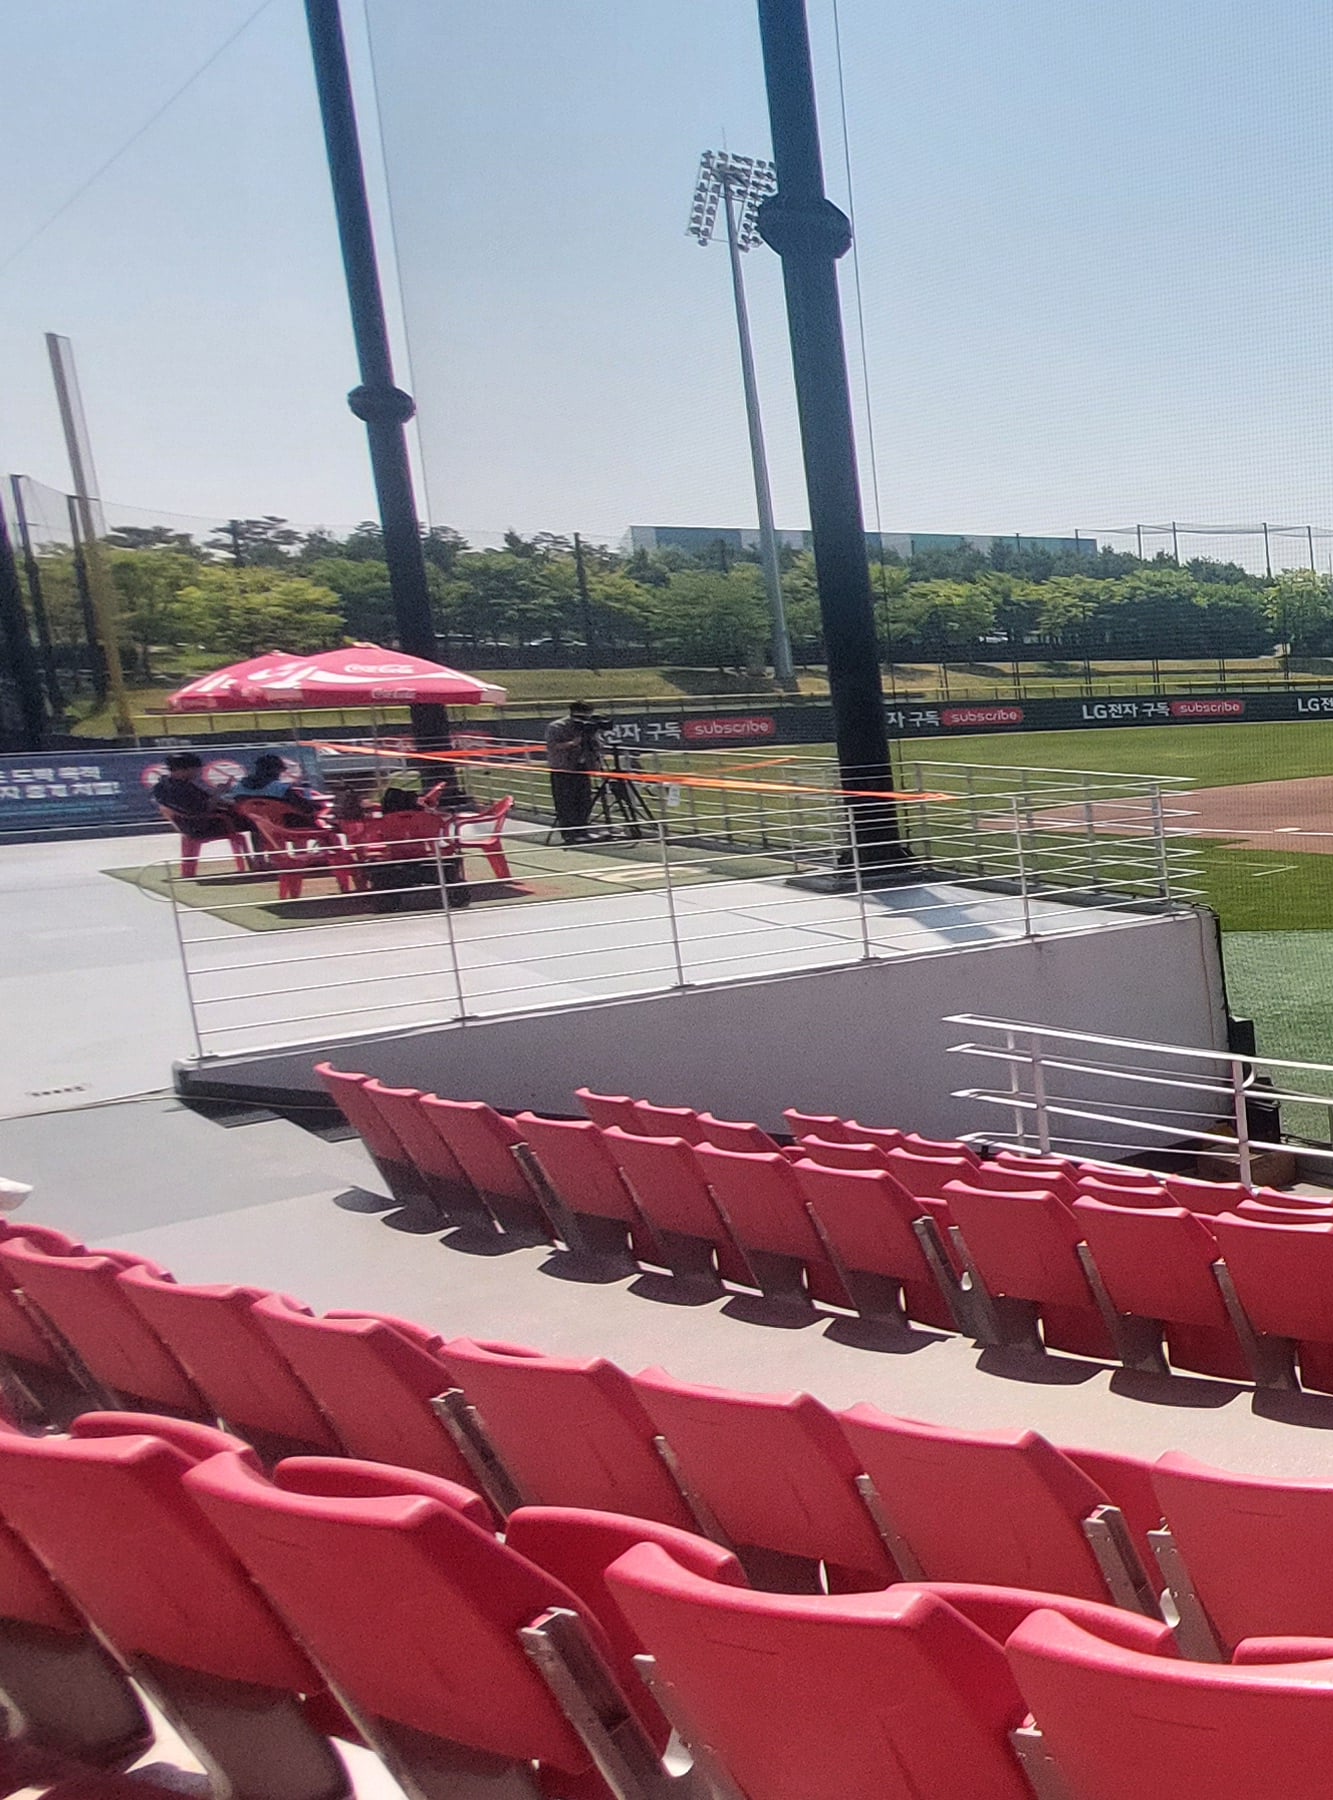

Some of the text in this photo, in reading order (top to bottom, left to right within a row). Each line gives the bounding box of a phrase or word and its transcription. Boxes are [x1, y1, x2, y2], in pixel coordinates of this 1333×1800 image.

[908, 710, 941, 728] 구독
[951, 709, 1018, 723] subscribe
[1082, 703, 1139, 720] LG전자
[1179, 701, 1240, 714] subscribe
[646, 721, 682, 741] 구독
[694, 720, 769, 736] subscribe
